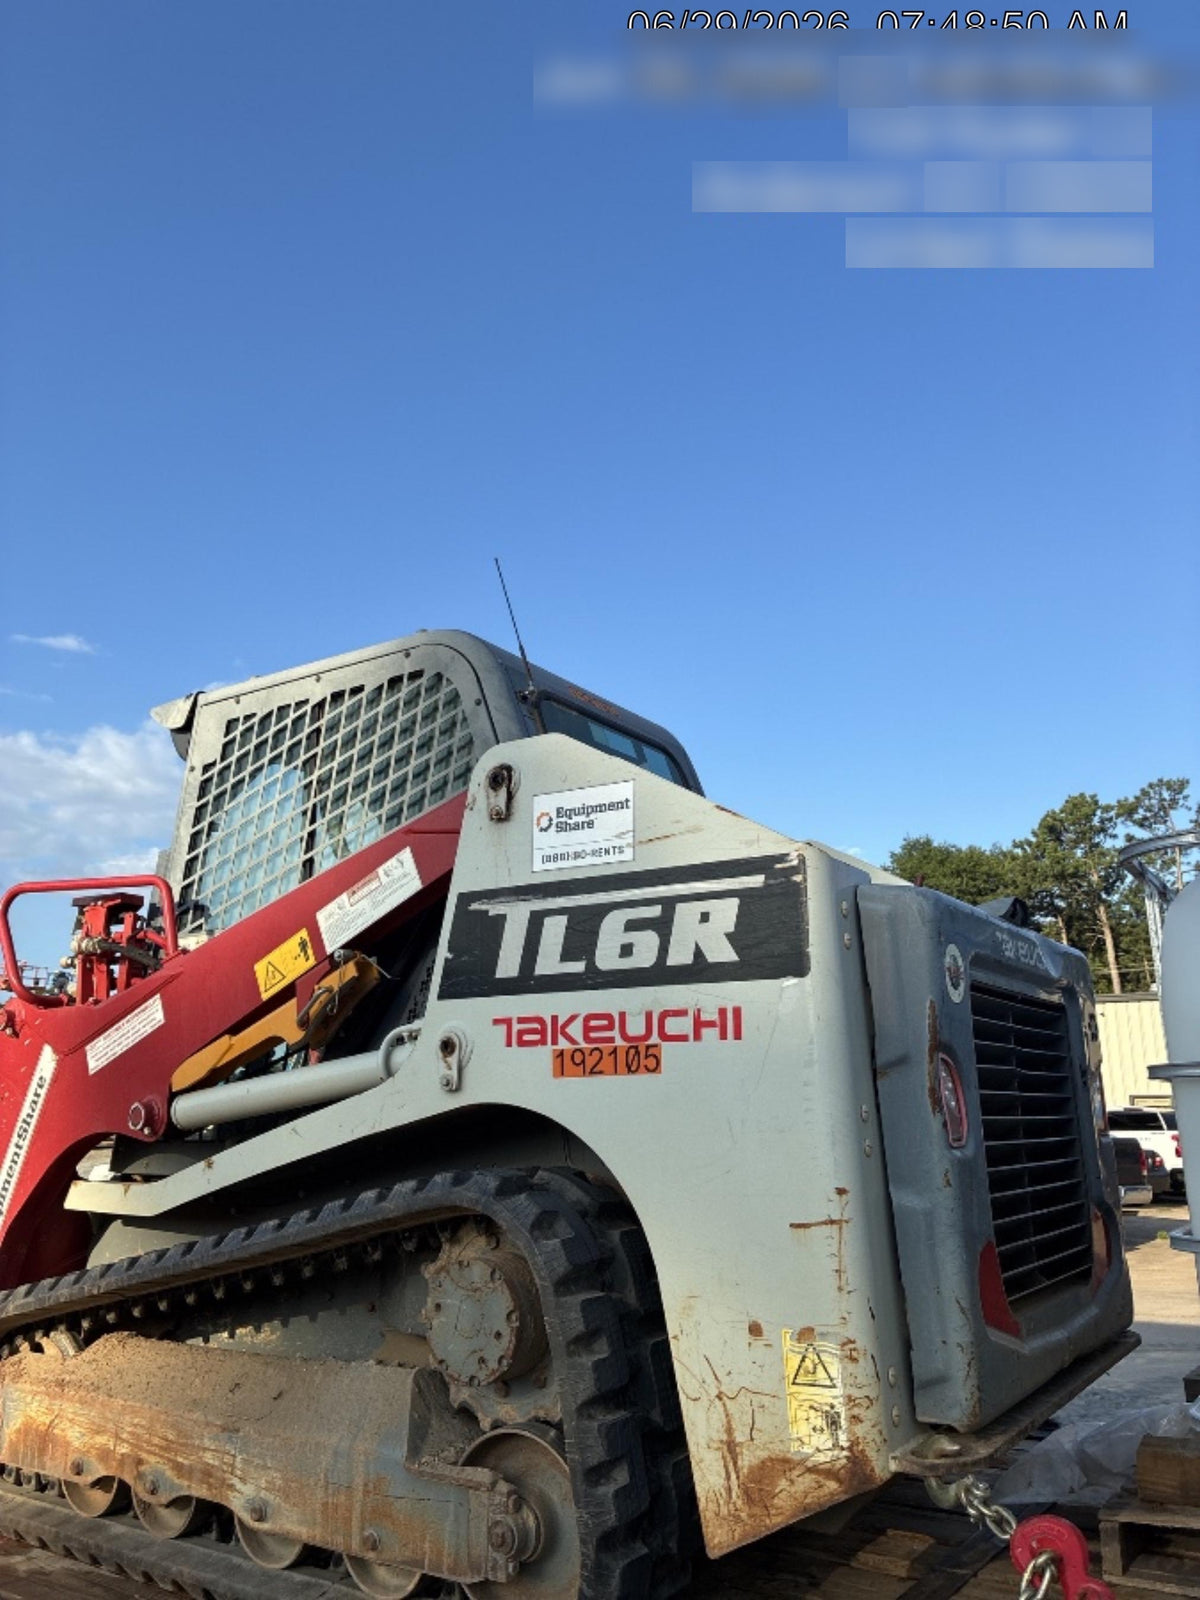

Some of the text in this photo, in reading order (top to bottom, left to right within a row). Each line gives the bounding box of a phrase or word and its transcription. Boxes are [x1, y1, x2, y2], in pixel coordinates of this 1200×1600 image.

[555, 797, 630, 820] Equipment
[554, 819, 595, 834] Share
[475, 888, 741, 979] TL6R
[555, 1044, 661, 1077] 192105
